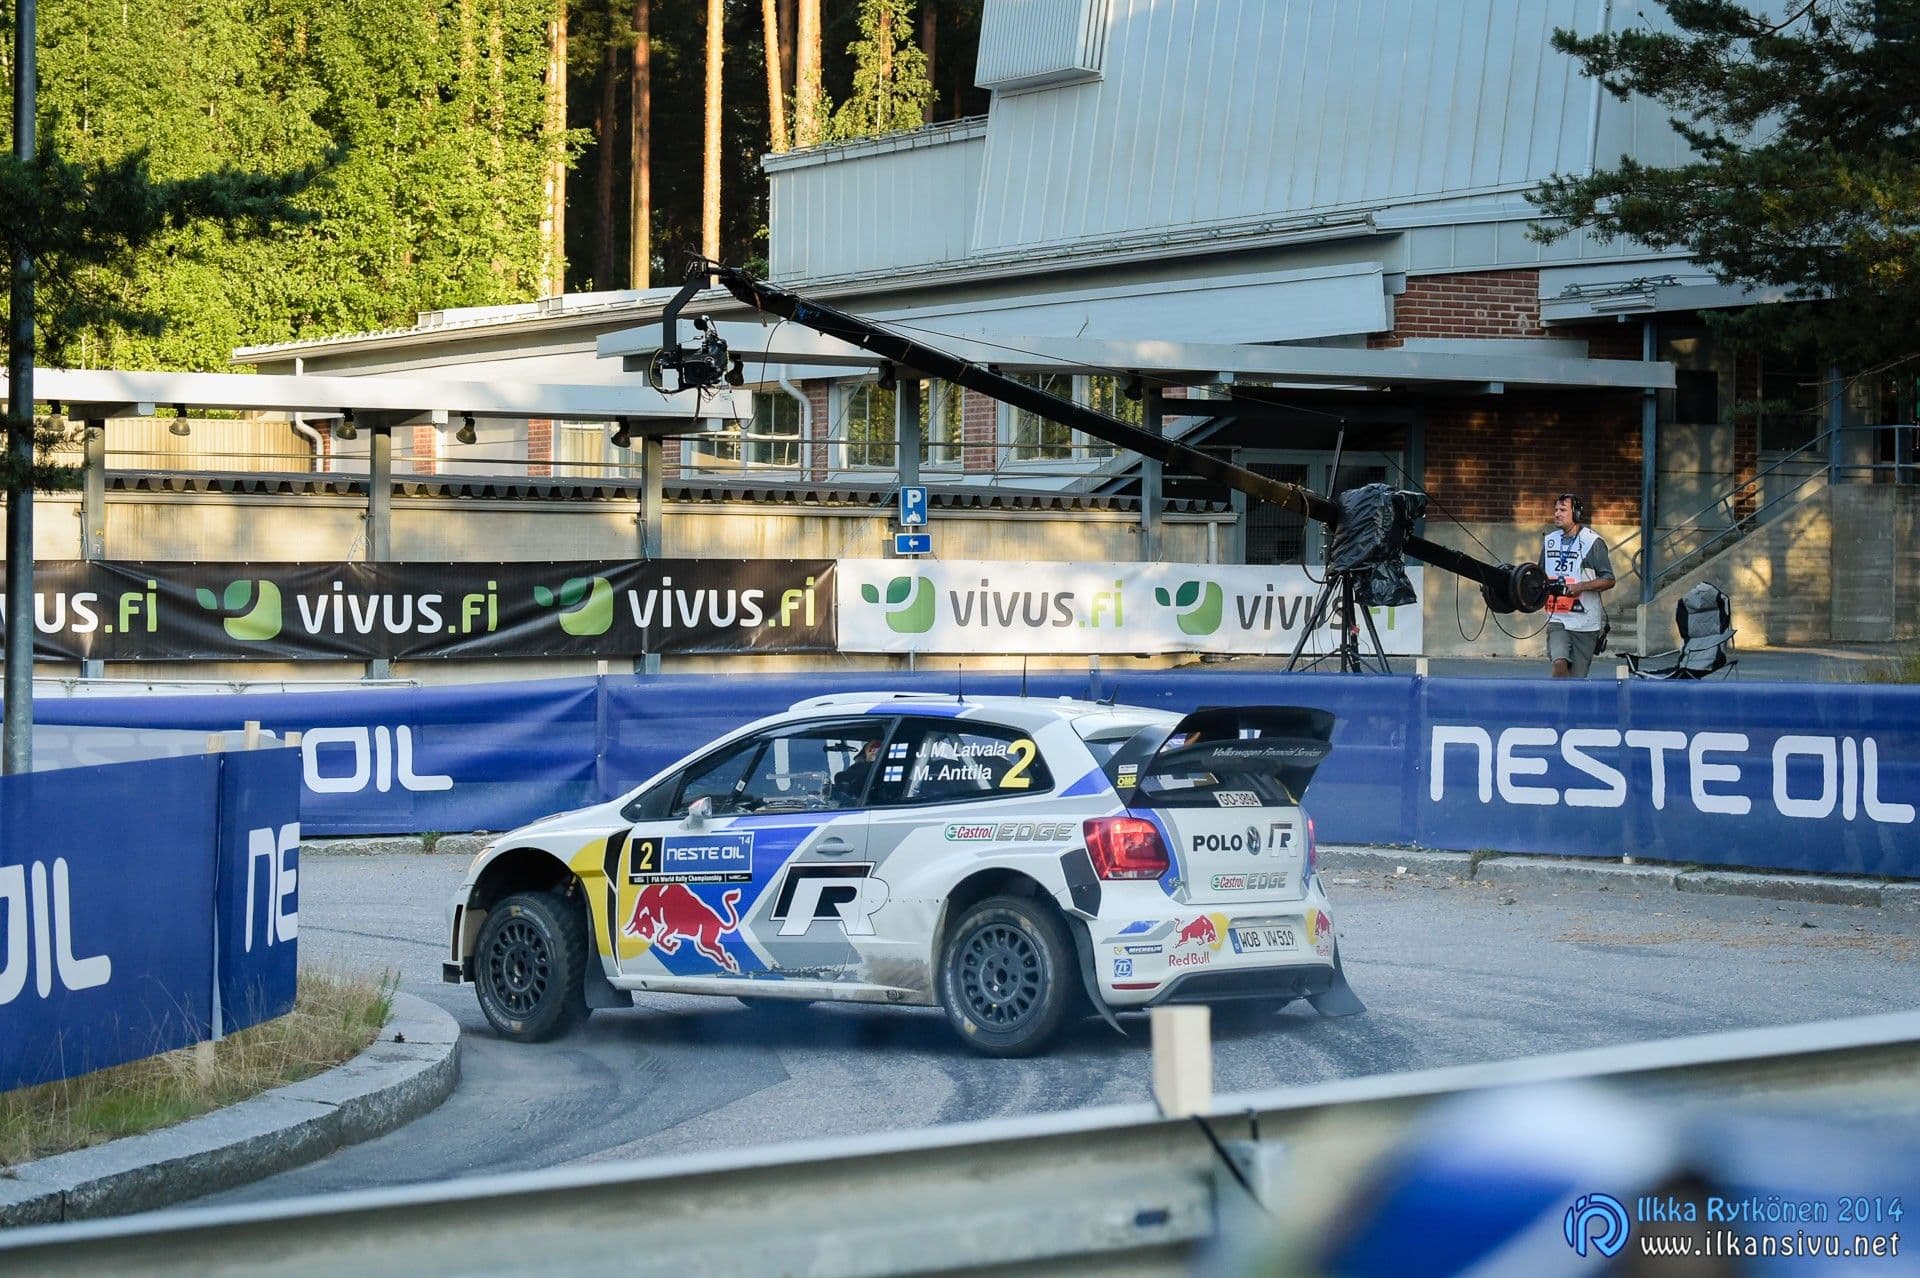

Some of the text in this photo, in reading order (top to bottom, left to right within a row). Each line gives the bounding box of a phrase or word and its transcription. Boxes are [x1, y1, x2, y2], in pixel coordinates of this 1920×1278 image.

[907, 489, 922, 509] P
[297, 580, 498, 634] vivus.fi
[628, 576, 815, 628] vivus.fi
[950, 578, 1123, 628] vivus.fi
[302, 724, 453, 793] OIL
[953, 741, 1006, 758] Latvala
[913, 763, 992, 781] M. Anttila
[999, 738, 1037, 788] 2
[1430, 725, 1916, 824] NESTE OIL
[957, 823, 1076, 841] Castrol EDGE
[1193, 834, 1243, 851] POLO
[640, 842, 653, 870] 2
[666, 846, 745, 860] NESTE OIL
[1220, 872, 1288, 889] Castrol EDGE
[1239, 931, 1261, 948] WOB
[1168, 952, 1210, 967] Red Bull
